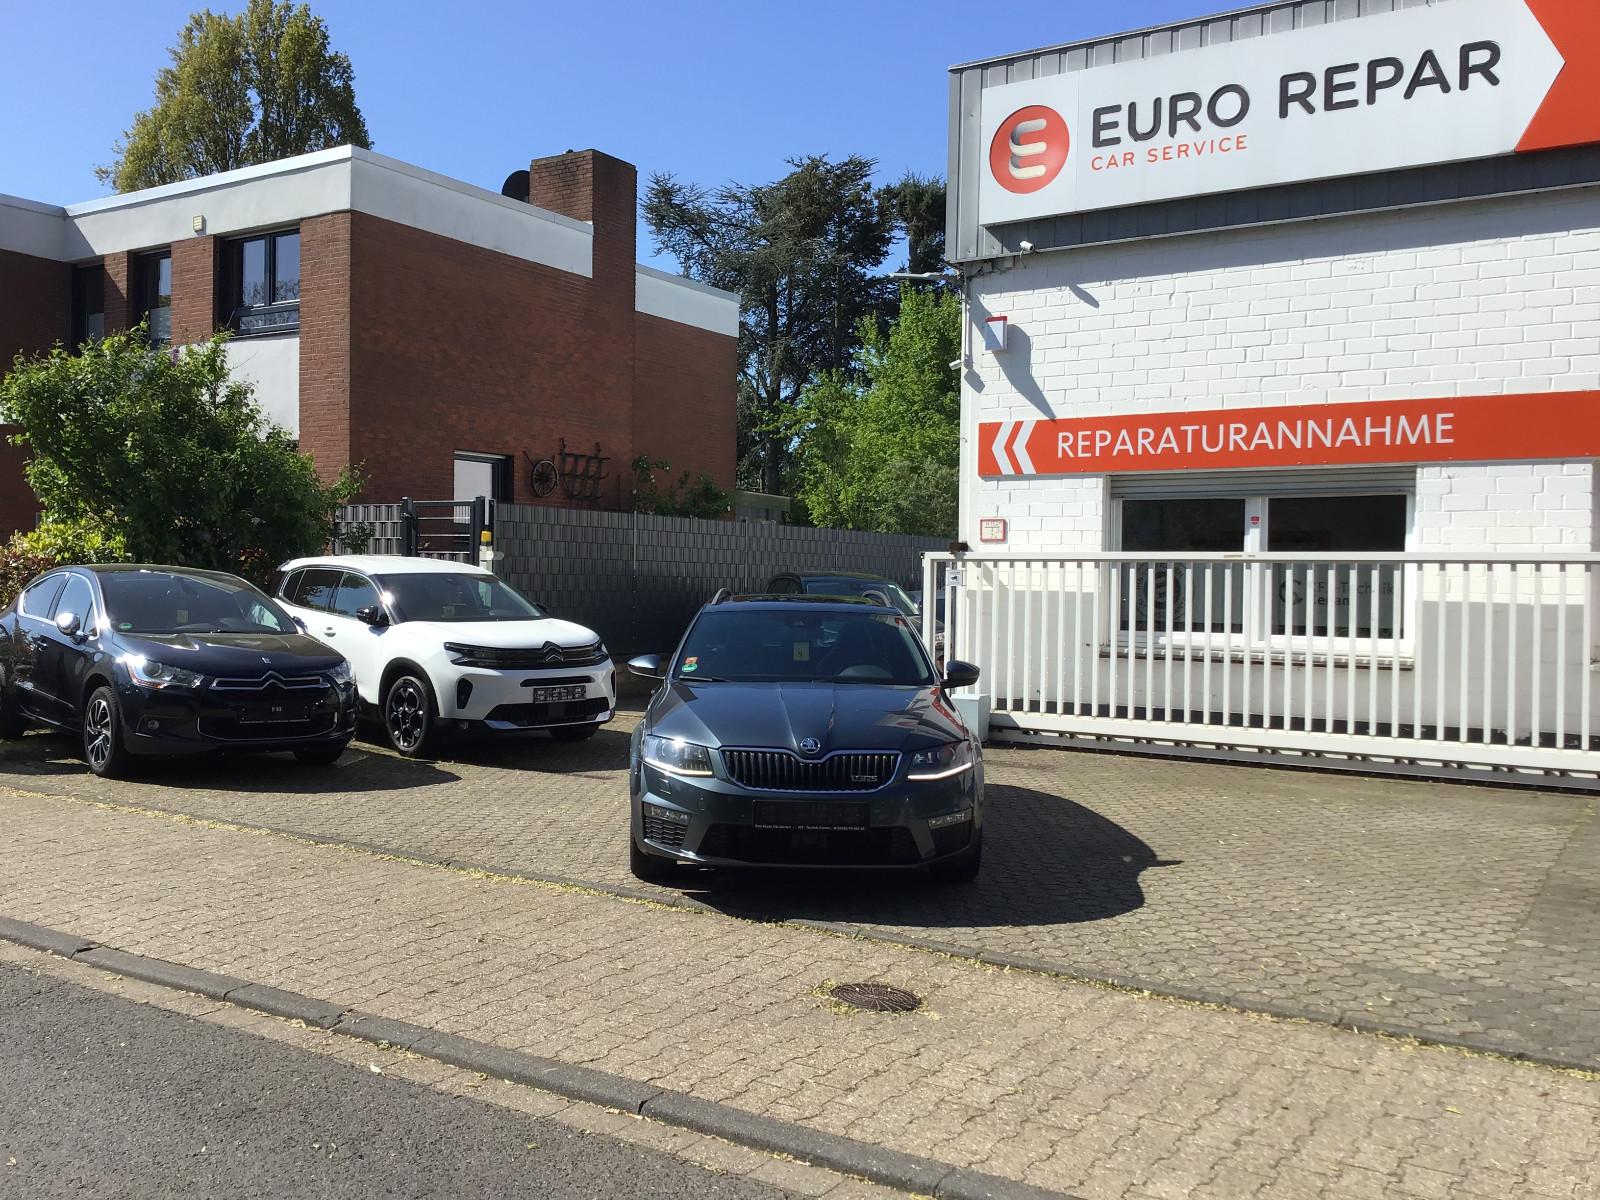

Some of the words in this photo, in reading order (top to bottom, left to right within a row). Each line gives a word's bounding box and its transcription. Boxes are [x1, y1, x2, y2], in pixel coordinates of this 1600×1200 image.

[1092, 83, 1250, 148] EURO
[1279, 39, 1501, 119] REPAR
[1091, 151, 1135, 171] CAR
[1147, 134, 1248, 163] SERVICE
[1057, 413, 1455, 458] REPARATURANNAHME
